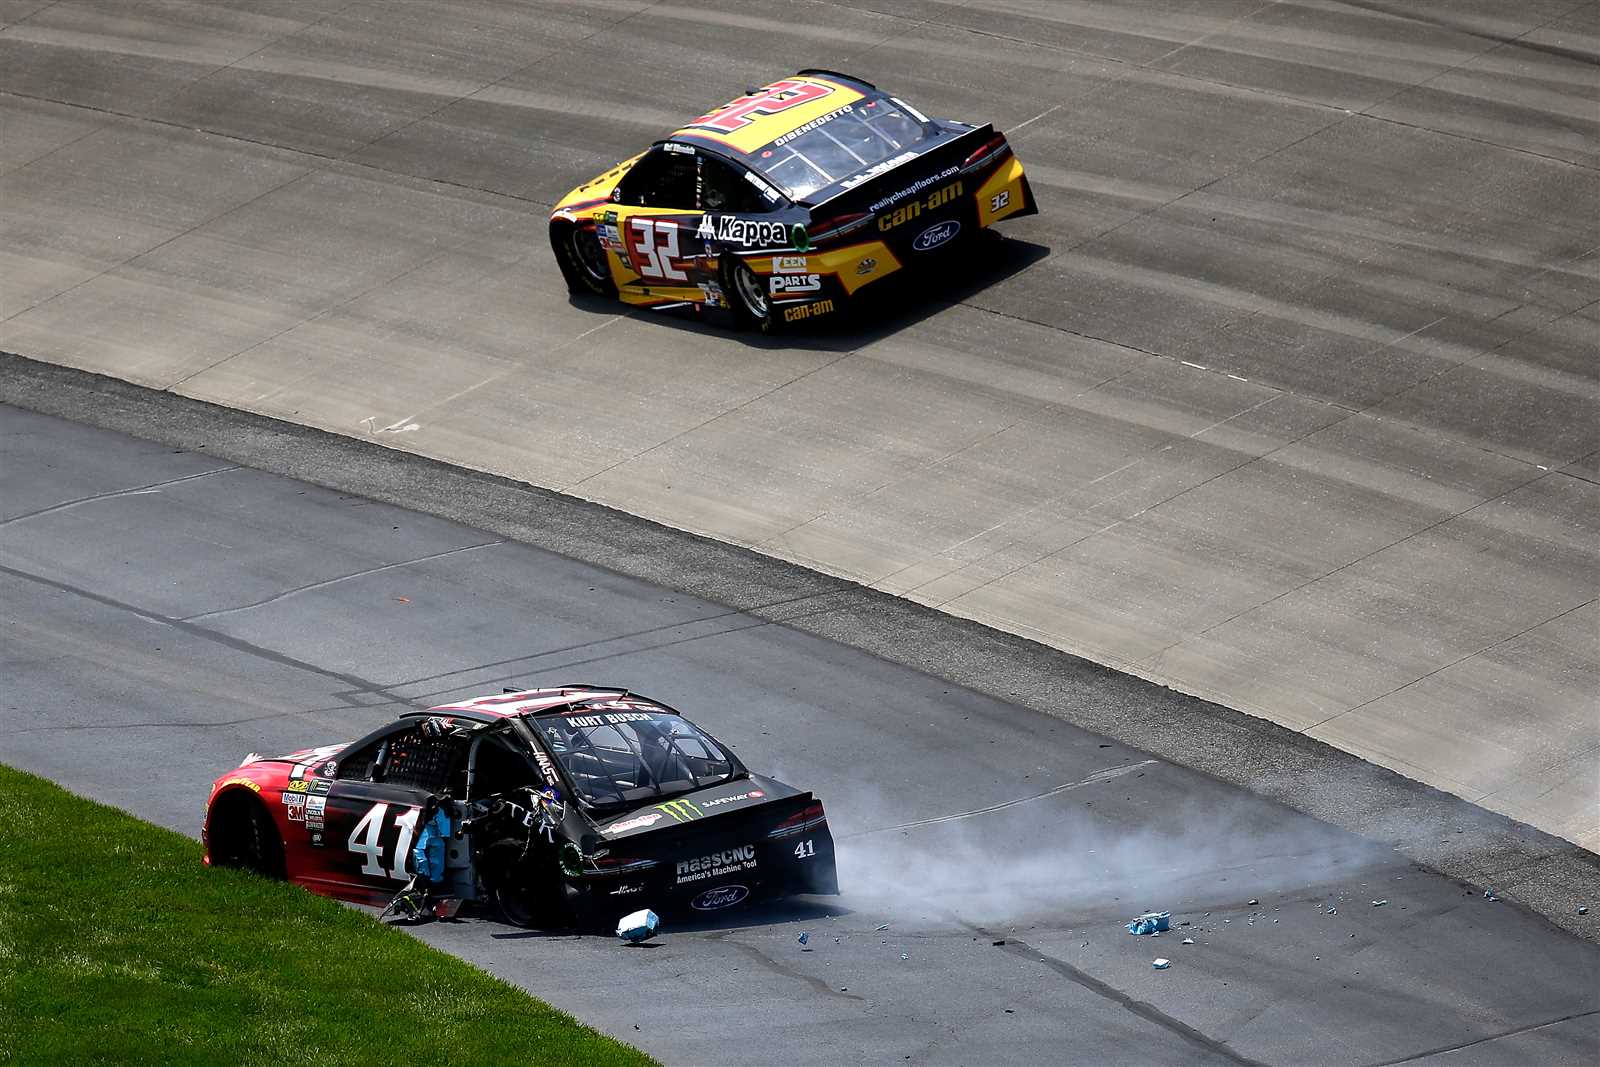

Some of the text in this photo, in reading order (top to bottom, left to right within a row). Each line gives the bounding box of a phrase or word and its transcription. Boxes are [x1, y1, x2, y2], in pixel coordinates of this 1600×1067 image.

[774, 105, 853, 147] DIBENEDETTO
[869, 164, 959, 213] reallycheapfloors.com
[877, 180, 964, 232] can-am
[991, 191, 1010, 212] 32
[718, 215, 788, 247] Kappa
[922, 225, 952, 247] Ford
[630, 218, 688, 281] 32
[783, 300, 834, 322] can-am
[566, 712, 654, 728] KURT BUSCH
[289, 805, 304, 820] 3M
[348, 803, 421, 882] 41
[794, 840, 817, 859] 41
[677, 859, 757, 884] America's Machine Tool
[702, 889, 738, 907] Ford
